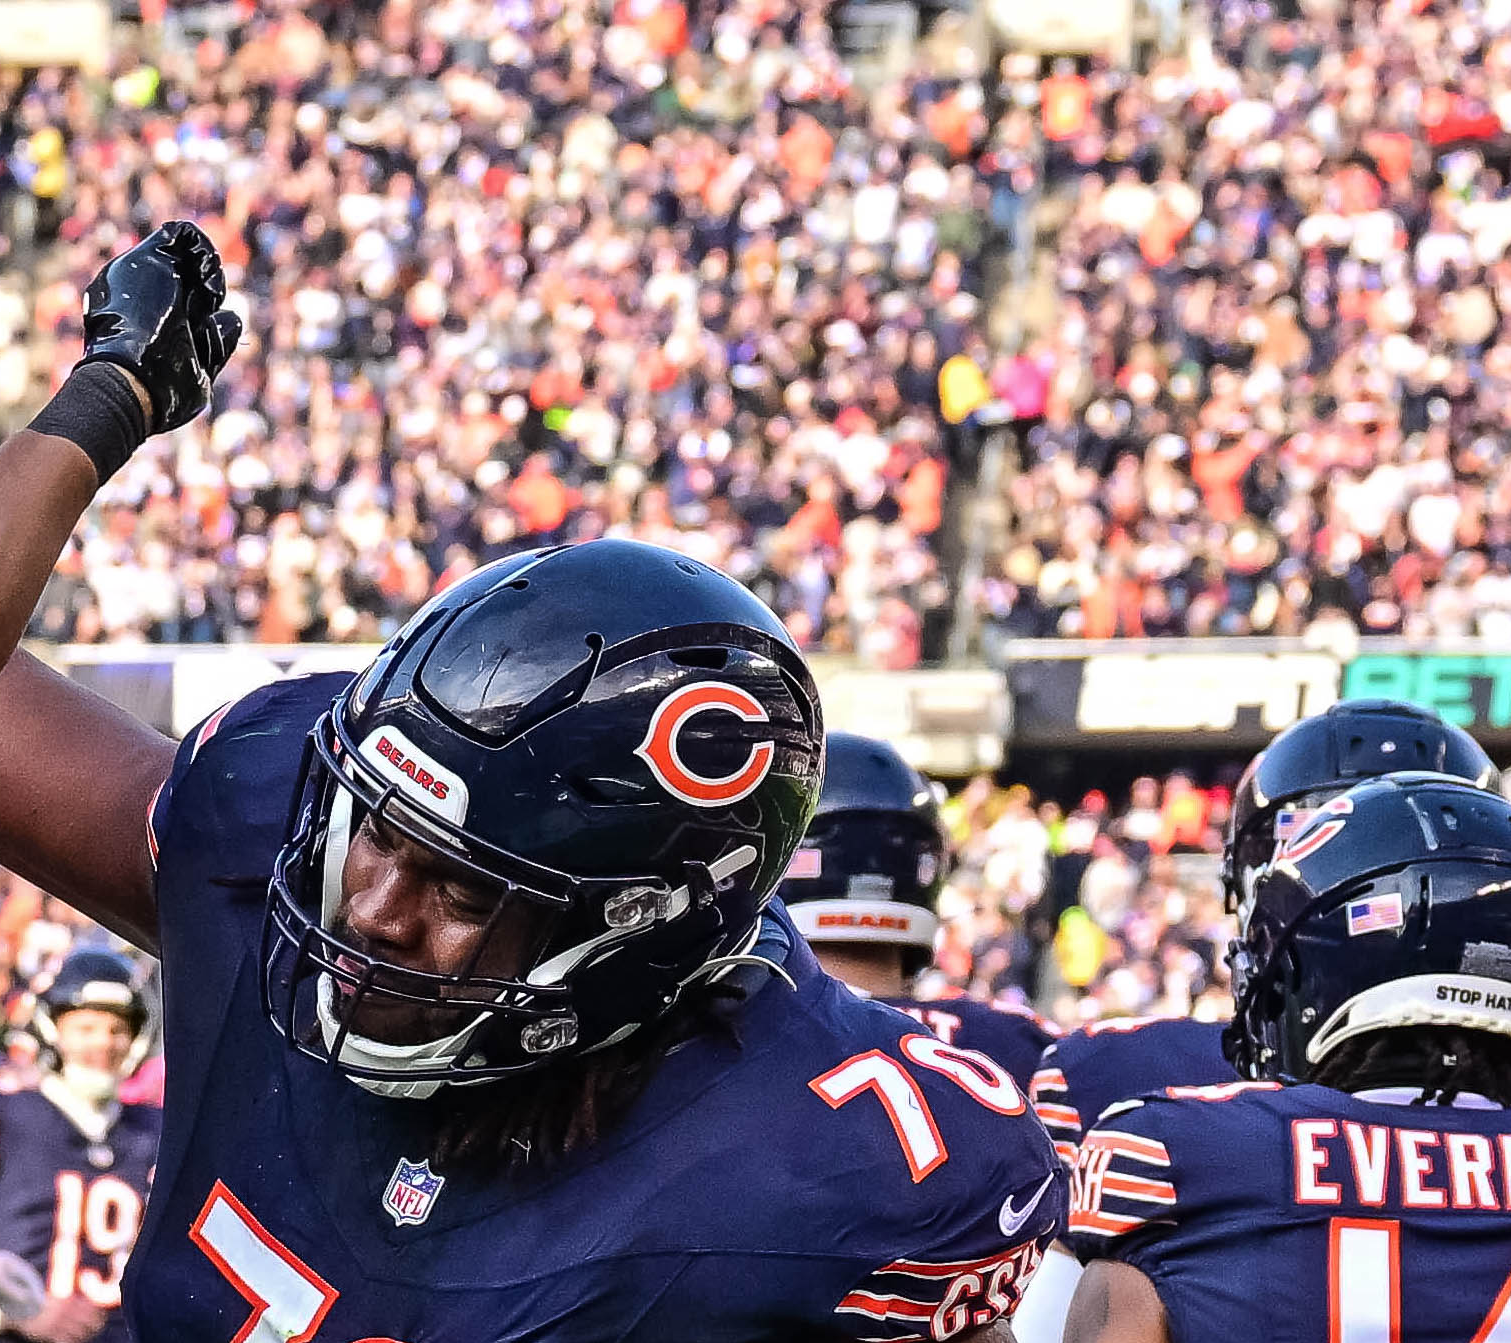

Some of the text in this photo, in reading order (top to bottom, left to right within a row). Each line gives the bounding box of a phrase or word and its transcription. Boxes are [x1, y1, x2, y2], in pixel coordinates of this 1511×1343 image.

[376, 735, 451, 801] BEARS
[633, 681, 775, 808] C
[1436, 985, 1481, 1005] STOP
[807, 1032, 1027, 1182] 70
[46, 1169, 147, 1308] 19
